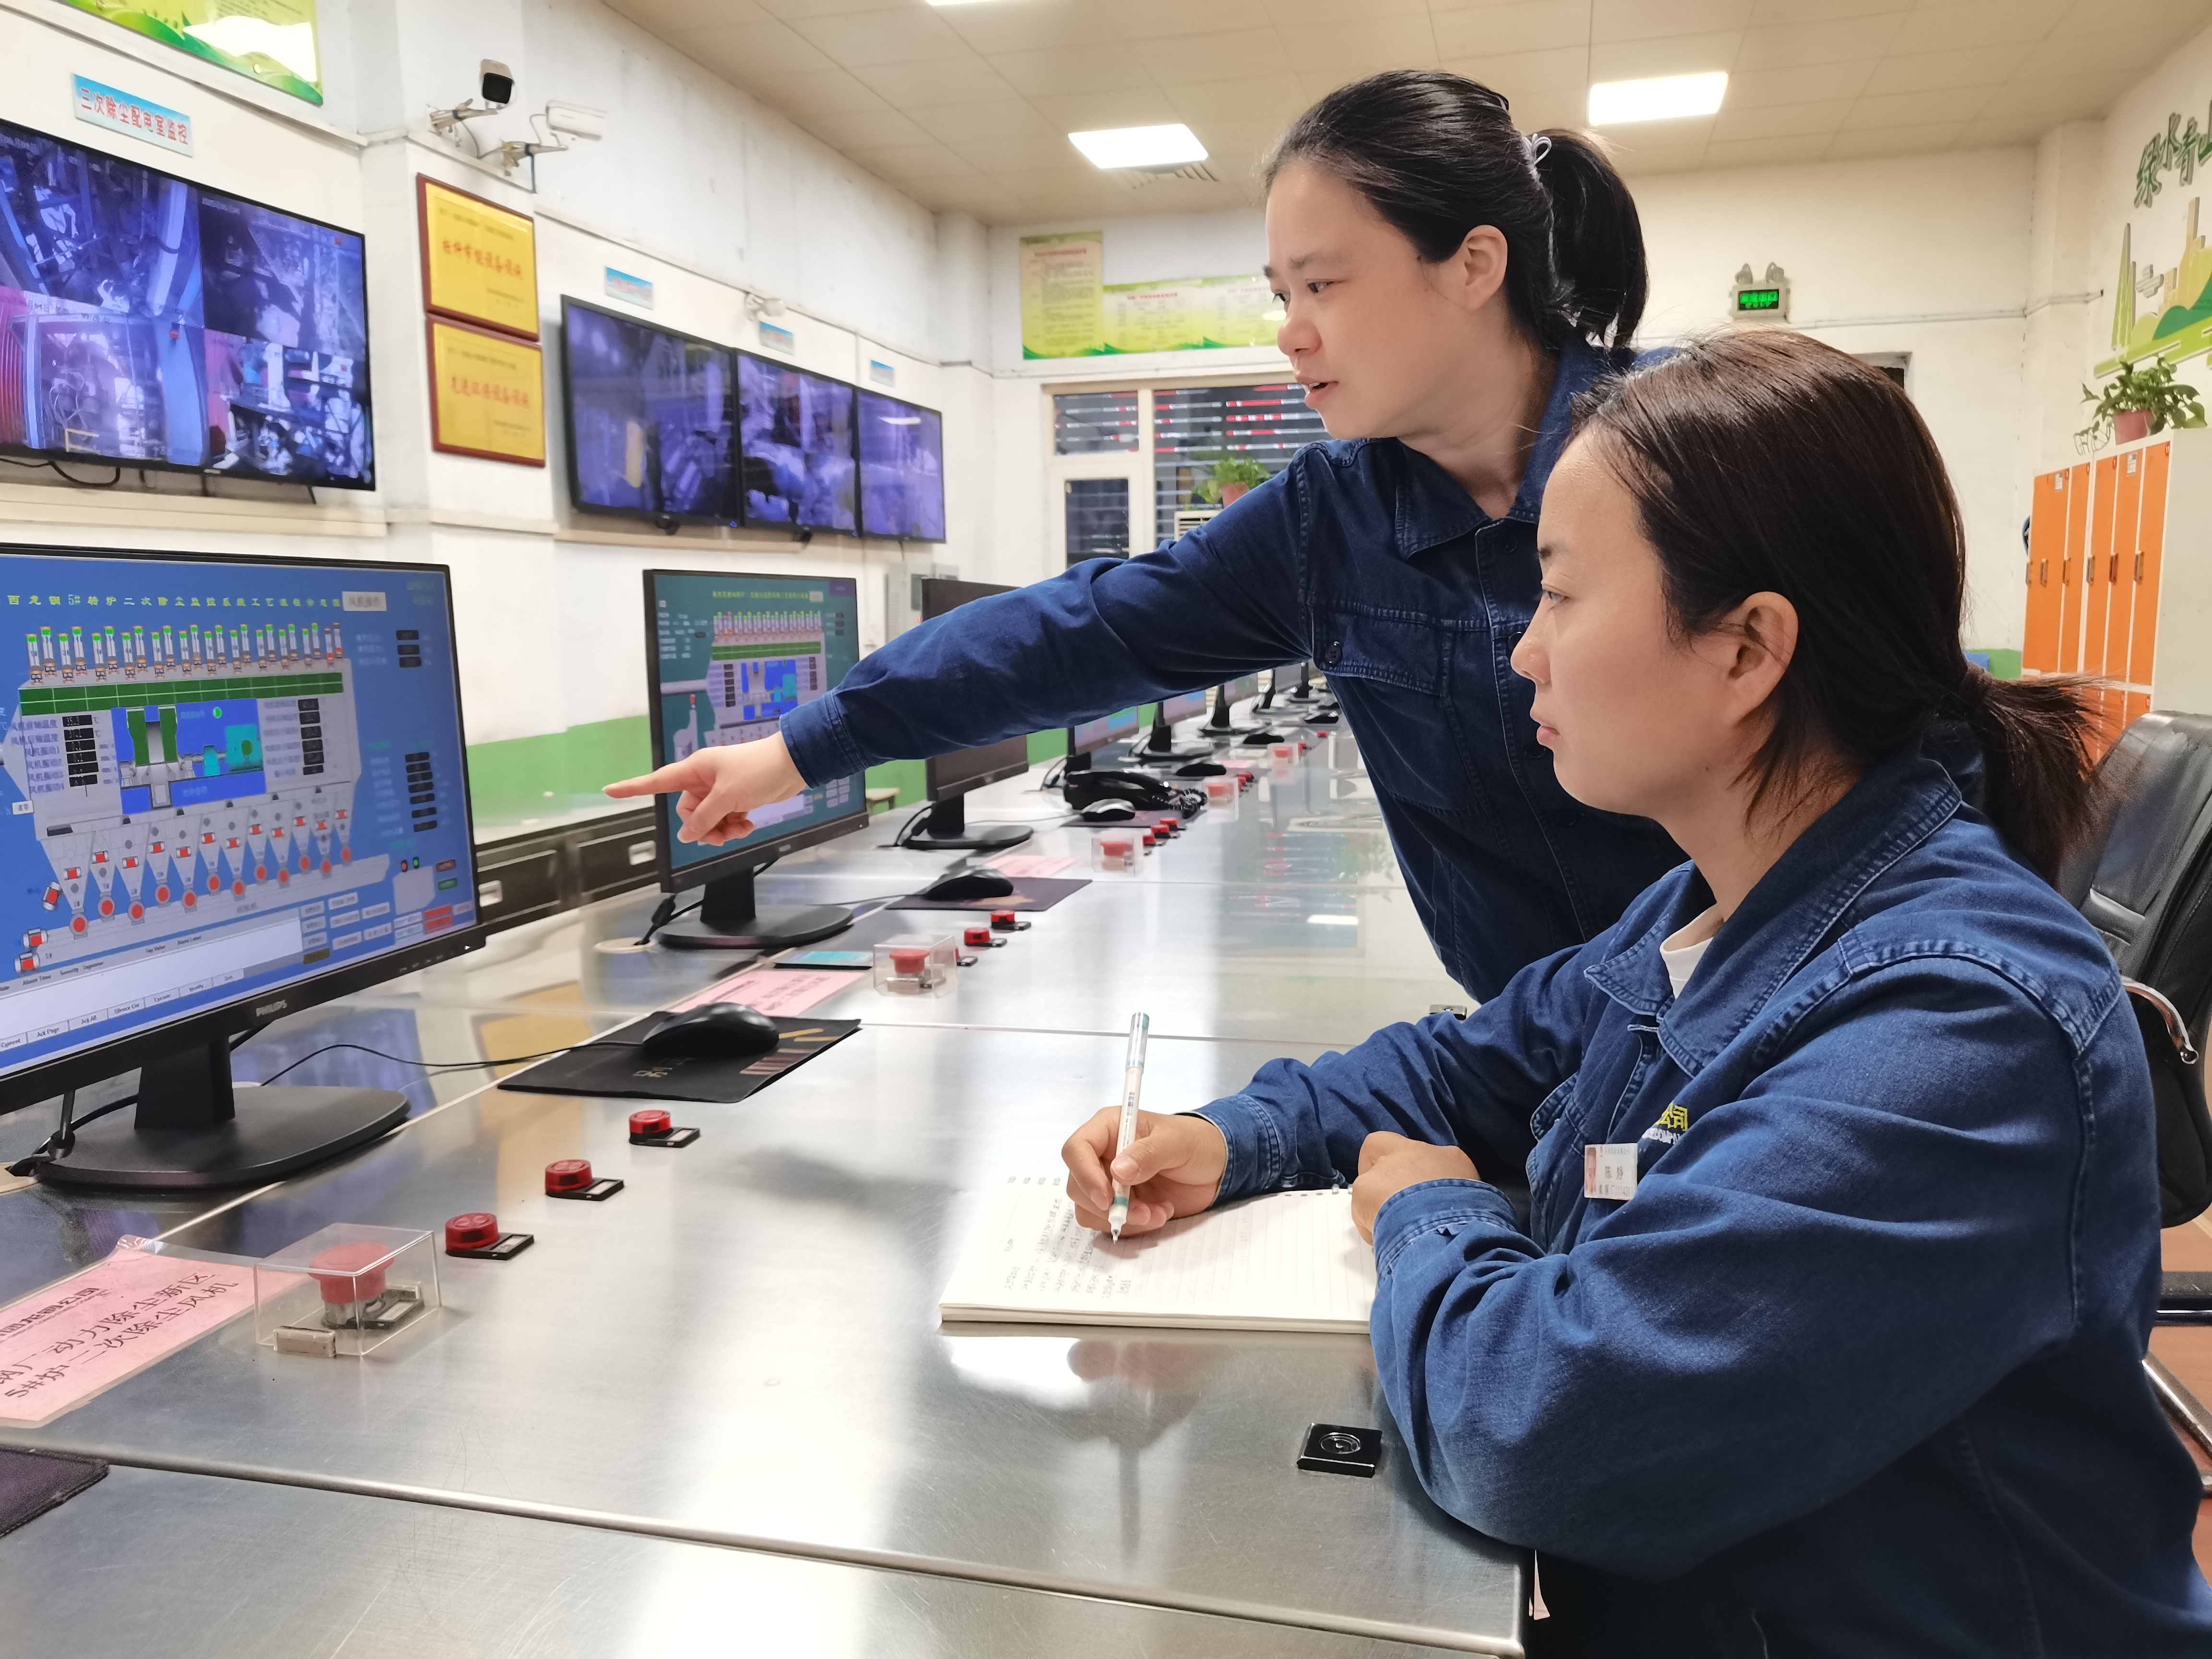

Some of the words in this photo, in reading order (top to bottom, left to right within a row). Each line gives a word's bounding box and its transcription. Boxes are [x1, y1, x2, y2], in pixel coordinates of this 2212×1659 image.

[80, 87, 189, 145] 三次除尘配电室监控
[256, 999, 288, 1017] PHILIPS
[0, 1287, 100, 1336] 团龙钢公司
